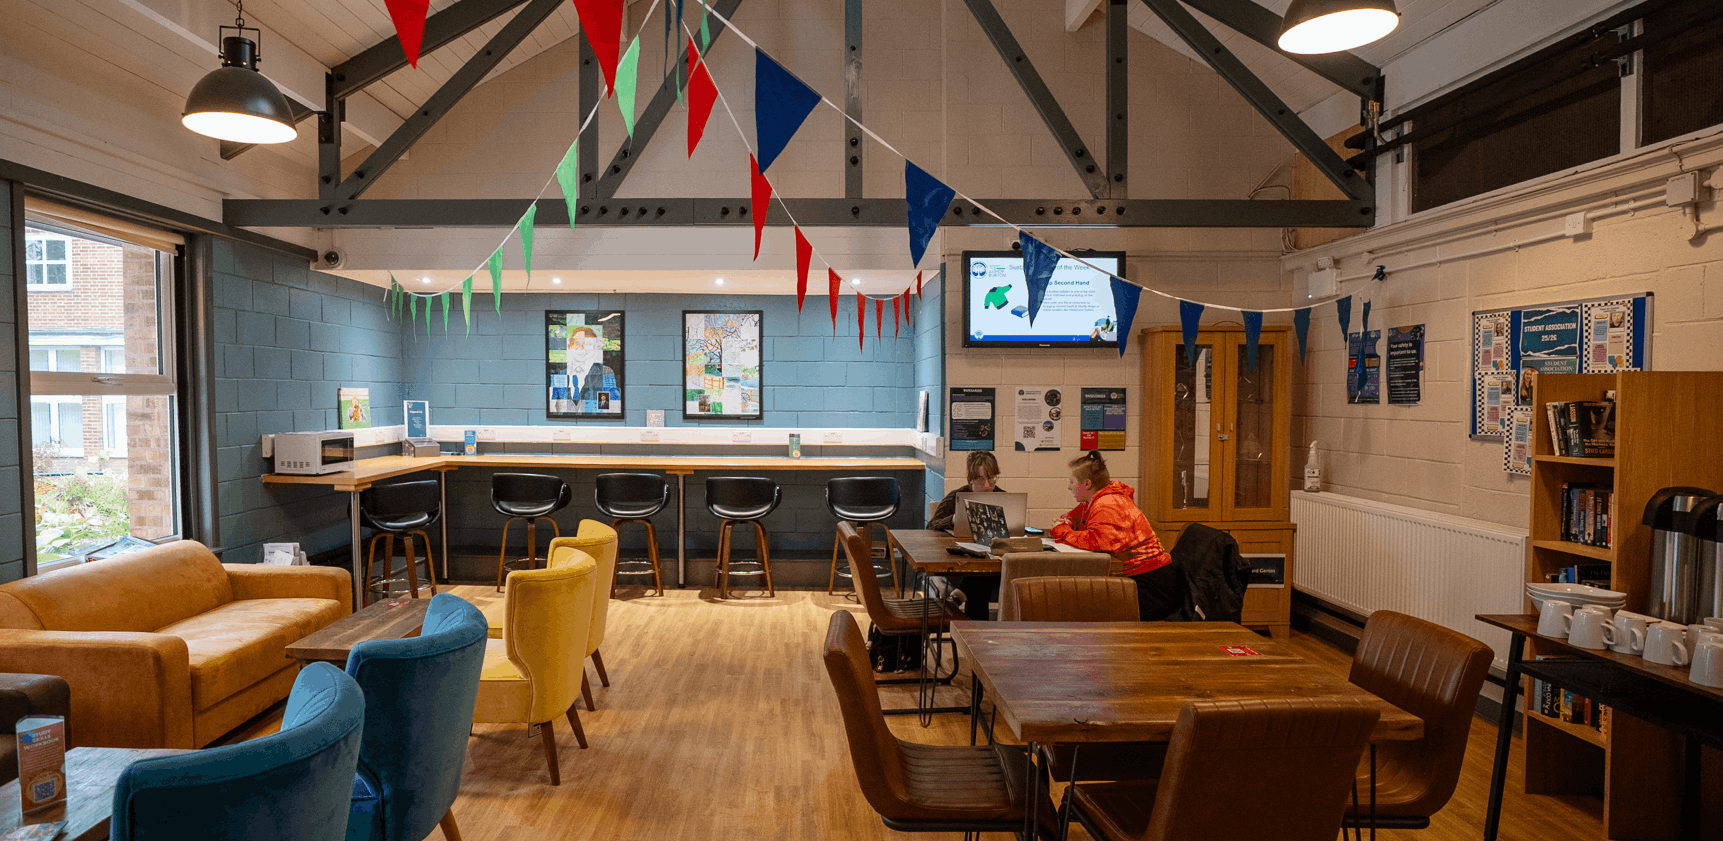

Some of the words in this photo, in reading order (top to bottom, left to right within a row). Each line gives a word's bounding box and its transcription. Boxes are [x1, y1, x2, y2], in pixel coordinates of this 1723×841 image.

[1524, 325, 1545, 333] STUDENT
[1545, 322, 1577, 331] ASSOCIATION
[1541, 334, 1557, 342] 25/26
[31, 728, 52, 738] STUDY
[23, 736, 59, 750] WORKBOOK
